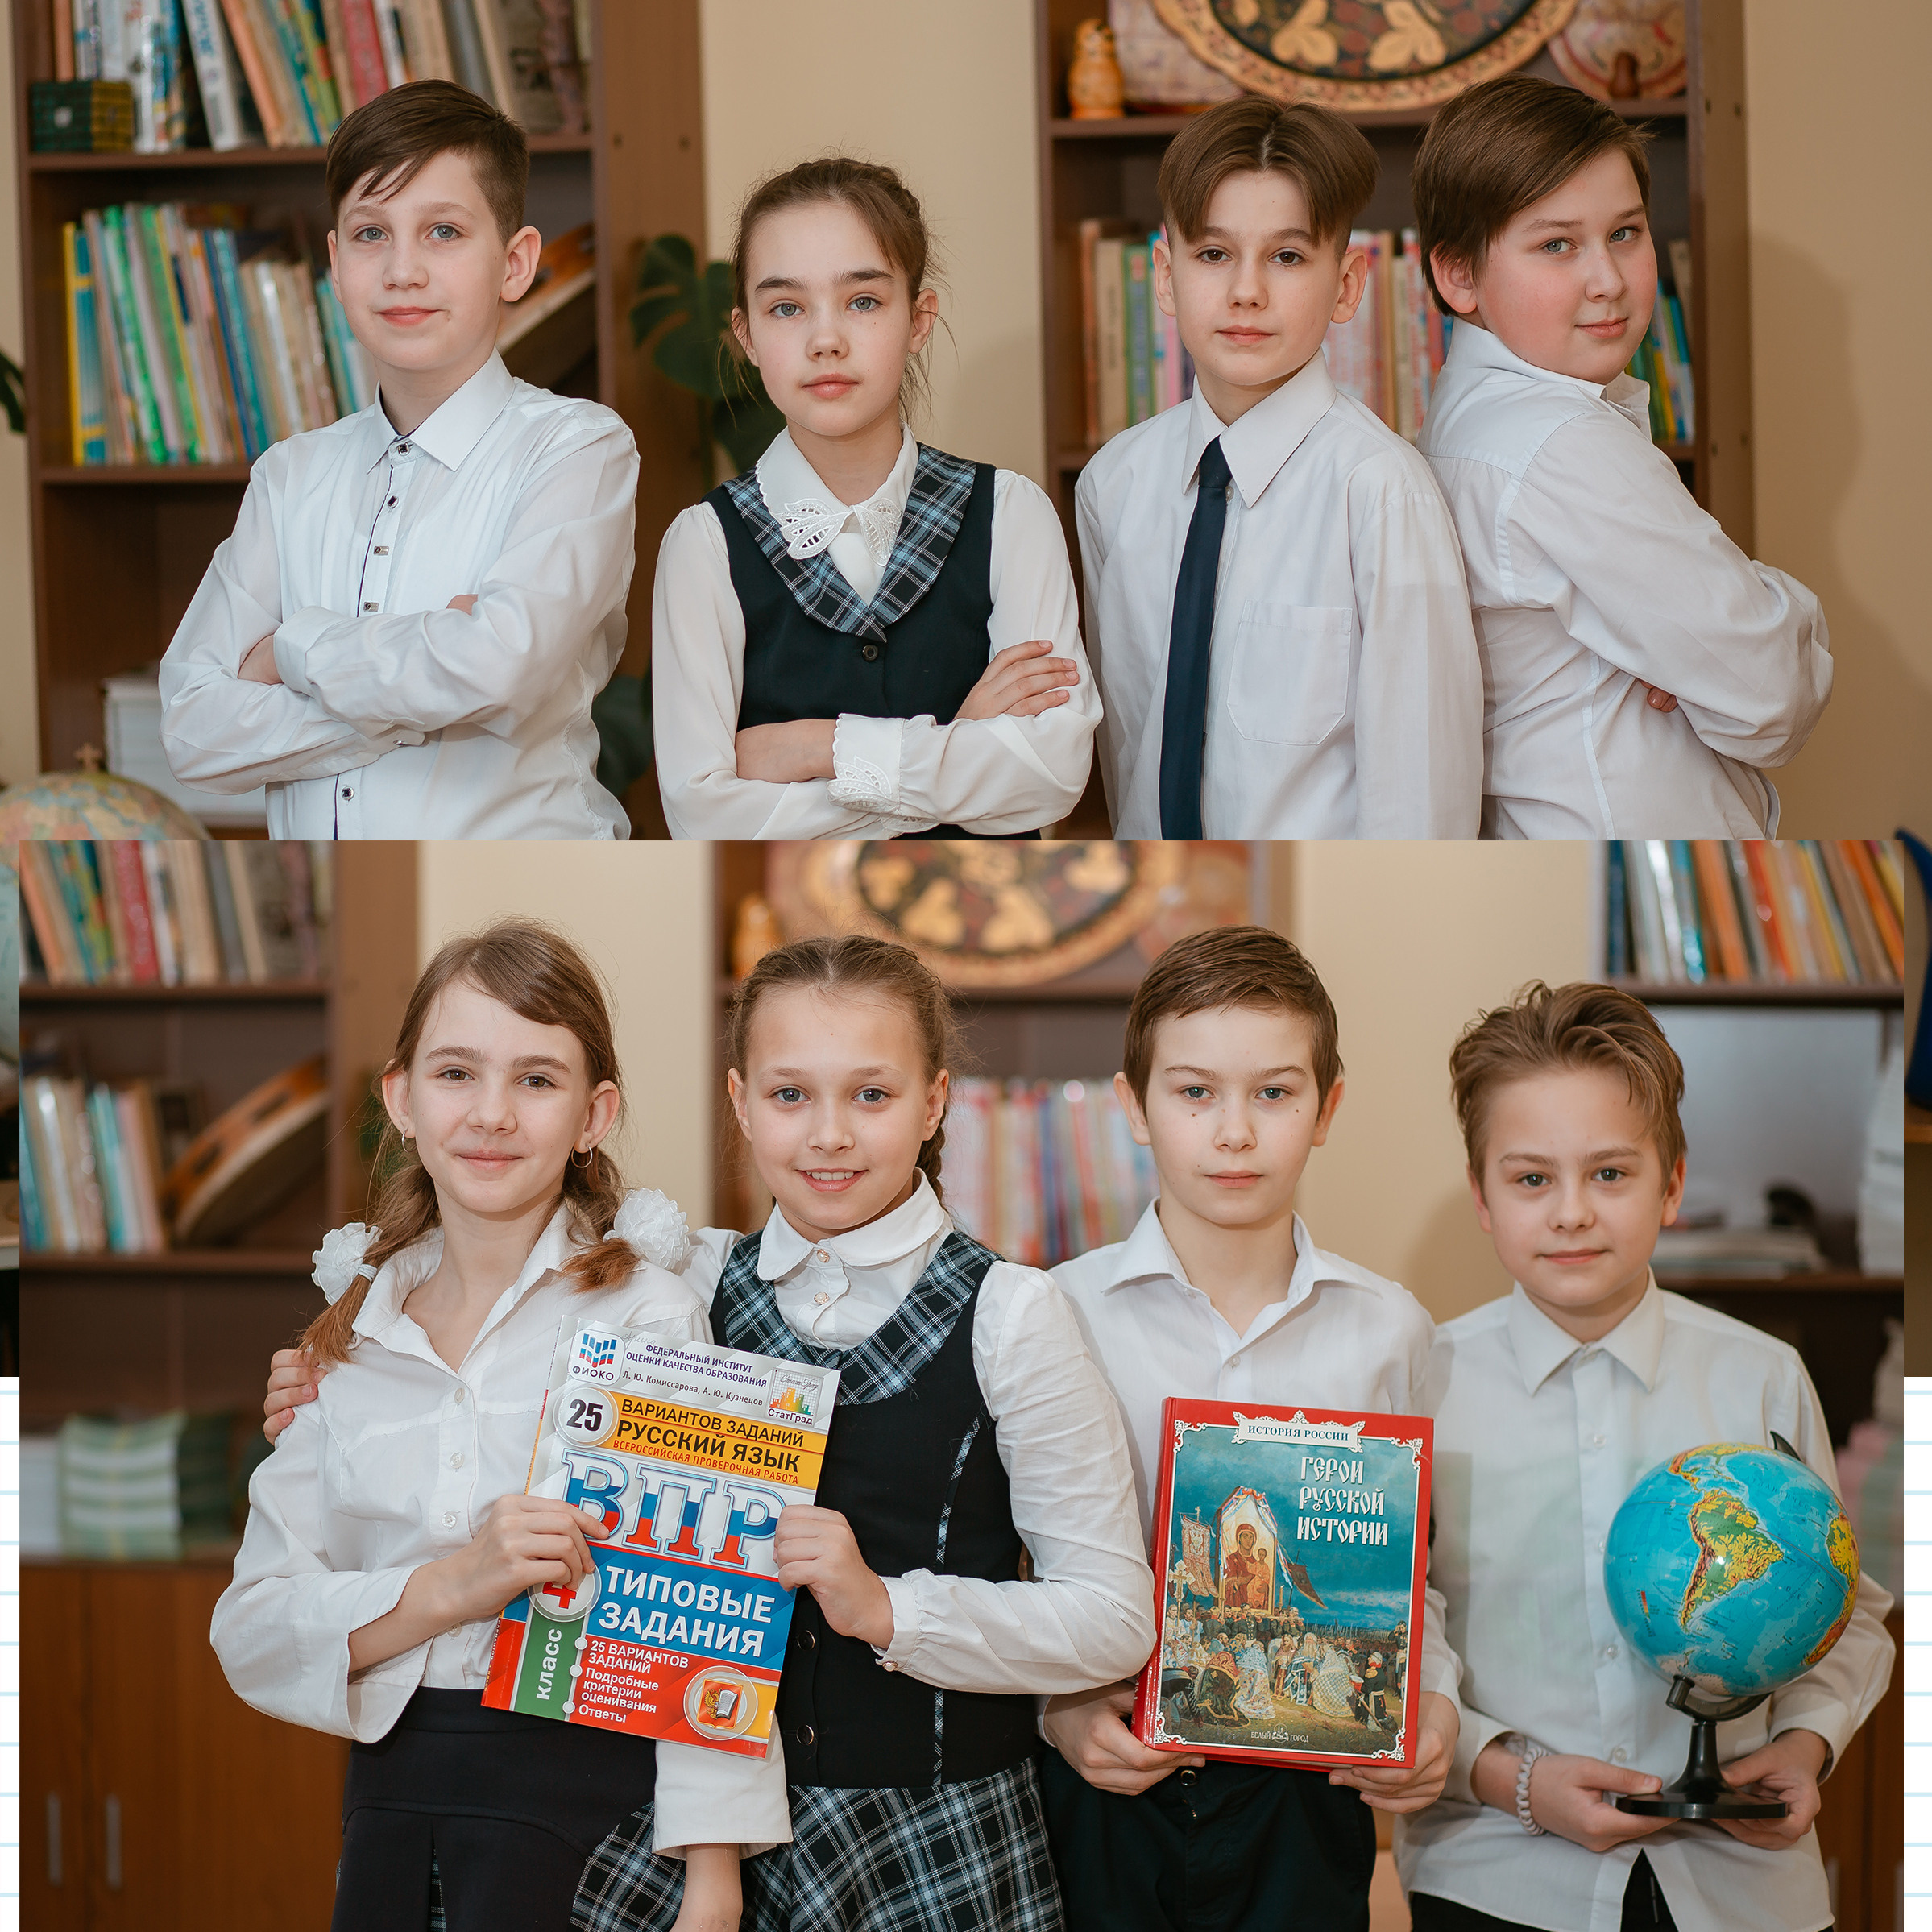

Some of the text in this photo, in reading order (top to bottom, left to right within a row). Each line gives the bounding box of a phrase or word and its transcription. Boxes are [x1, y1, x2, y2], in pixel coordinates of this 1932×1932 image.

[573, 1366, 614, 1380] ФИОКО
[626, 1352, 768, 1387] ОЦЕНКИ КАЧЕСТВА ОБРАЗОВАНИЯ
[645, 1344, 752, 1373] ФЕДЕРАЛЬНЫЙ ИНСТИТУТ
[622, 1370, 763, 1406] Л. Ю. Комиссарова, А. Ю. Кузнецов
[566, 1399, 603, 1432] 25
[621, 1399, 804, 1447] ВАРИАНТОВ ЗАДАНИЙ
[768, 1408, 813, 1425] СтатГрад
[617, 1420, 801, 1473] РУССКИЙ ЯЗЫК
[1248, 1425, 1349, 1441] ИСТОРИЯ РОССИИ
[613, 1440, 798, 1484] ВСЕРОССИЙСКАЯ ПРОВЕРОЧНАЯ РАБОТА
[1300, 1457, 1364, 1484] ГЕРОИ
[562, 1448, 786, 1569] ВПР
[1299, 1486, 1385, 1515] РУССКОЙ
[1297, 1516, 1388, 1546] ИСТОРИИ
[606, 1565, 776, 1623] ТИПОВЫЕ
[598, 1602, 765, 1657] ЗАДАНИЯ
[536, 1628, 562, 1700] класс
[588, 1652, 652, 1674] ЗАДАНИЙ
[590, 1640, 689, 1669] 25 ВАРИАНТОВ
[583, 1681, 642, 1699] критерии
[585, 1667, 659, 1691] Подробные
[578, 1704, 627, 1723] Ответы
[581, 1692, 657, 1714] оценивания
[1250, 1731, 1309, 1743] БЕЛЫЙ ГОРОД
